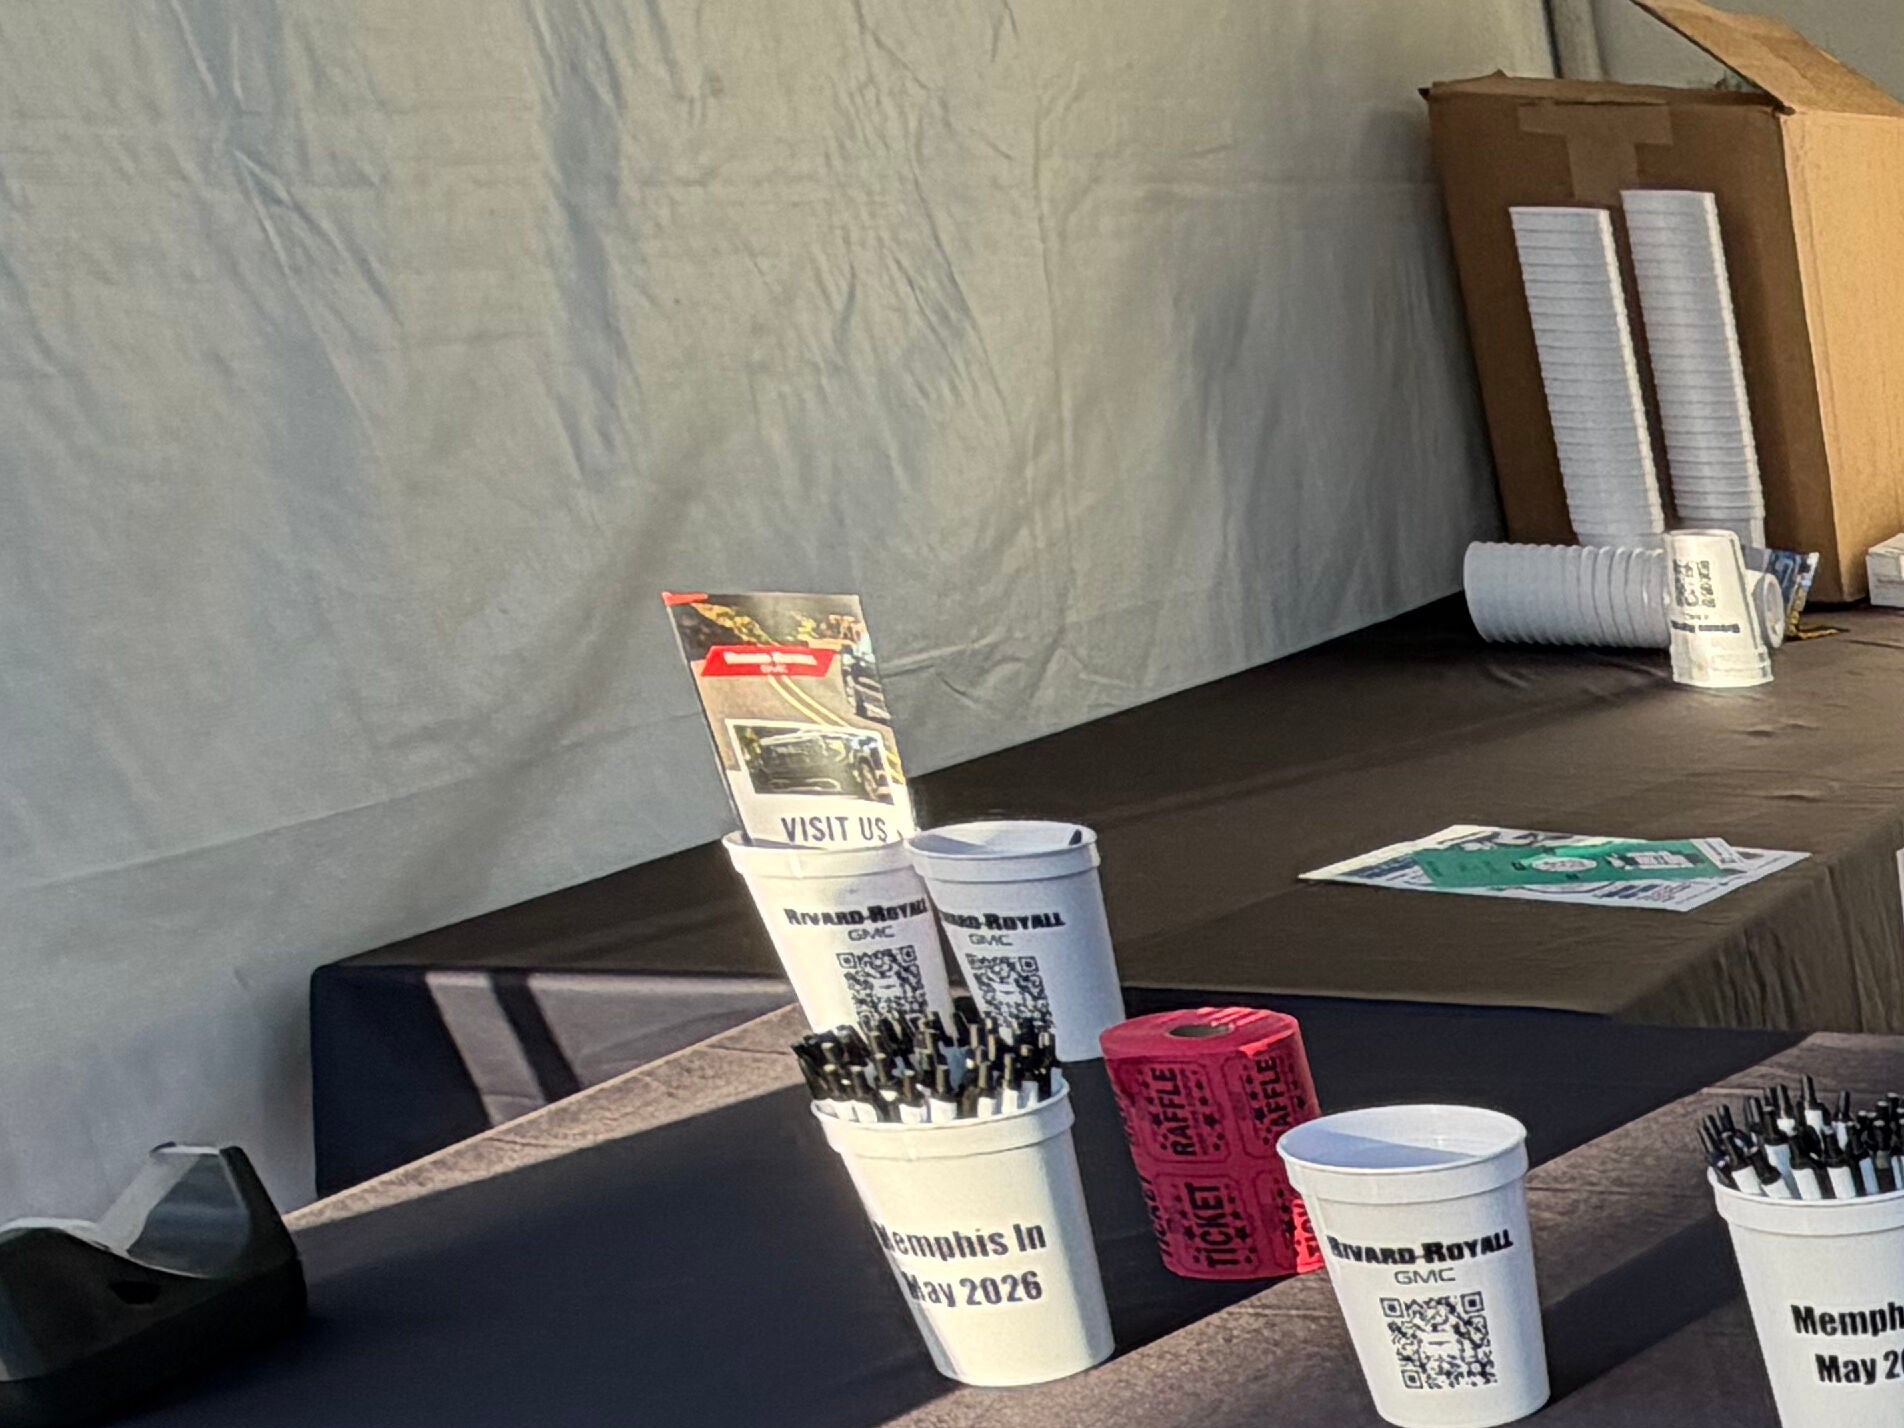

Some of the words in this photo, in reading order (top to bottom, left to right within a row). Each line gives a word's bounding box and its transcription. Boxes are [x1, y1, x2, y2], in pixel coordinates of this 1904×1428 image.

[781, 816, 848, 842] VISIT
[860, 817, 888, 842] US
[848, 925, 896, 942] GMC
[1256, 1055, 1292, 1128] AFFLE
[1151, 1066, 1198, 1157] RAFFLE
[873, 1220, 1009, 1261] Memphis
[1013, 1223, 1047, 1252] In
[1184, 1182, 1241, 1268] TICKET
[1326, 1229, 1514, 1265] RIVARD-ROYALL
[901, 1270, 956, 1307] May
[959, 1270, 1042, 1305] 2026
[1394, 1267, 1456, 1286] GMC
[1815, 1353, 1877, 1385] May
